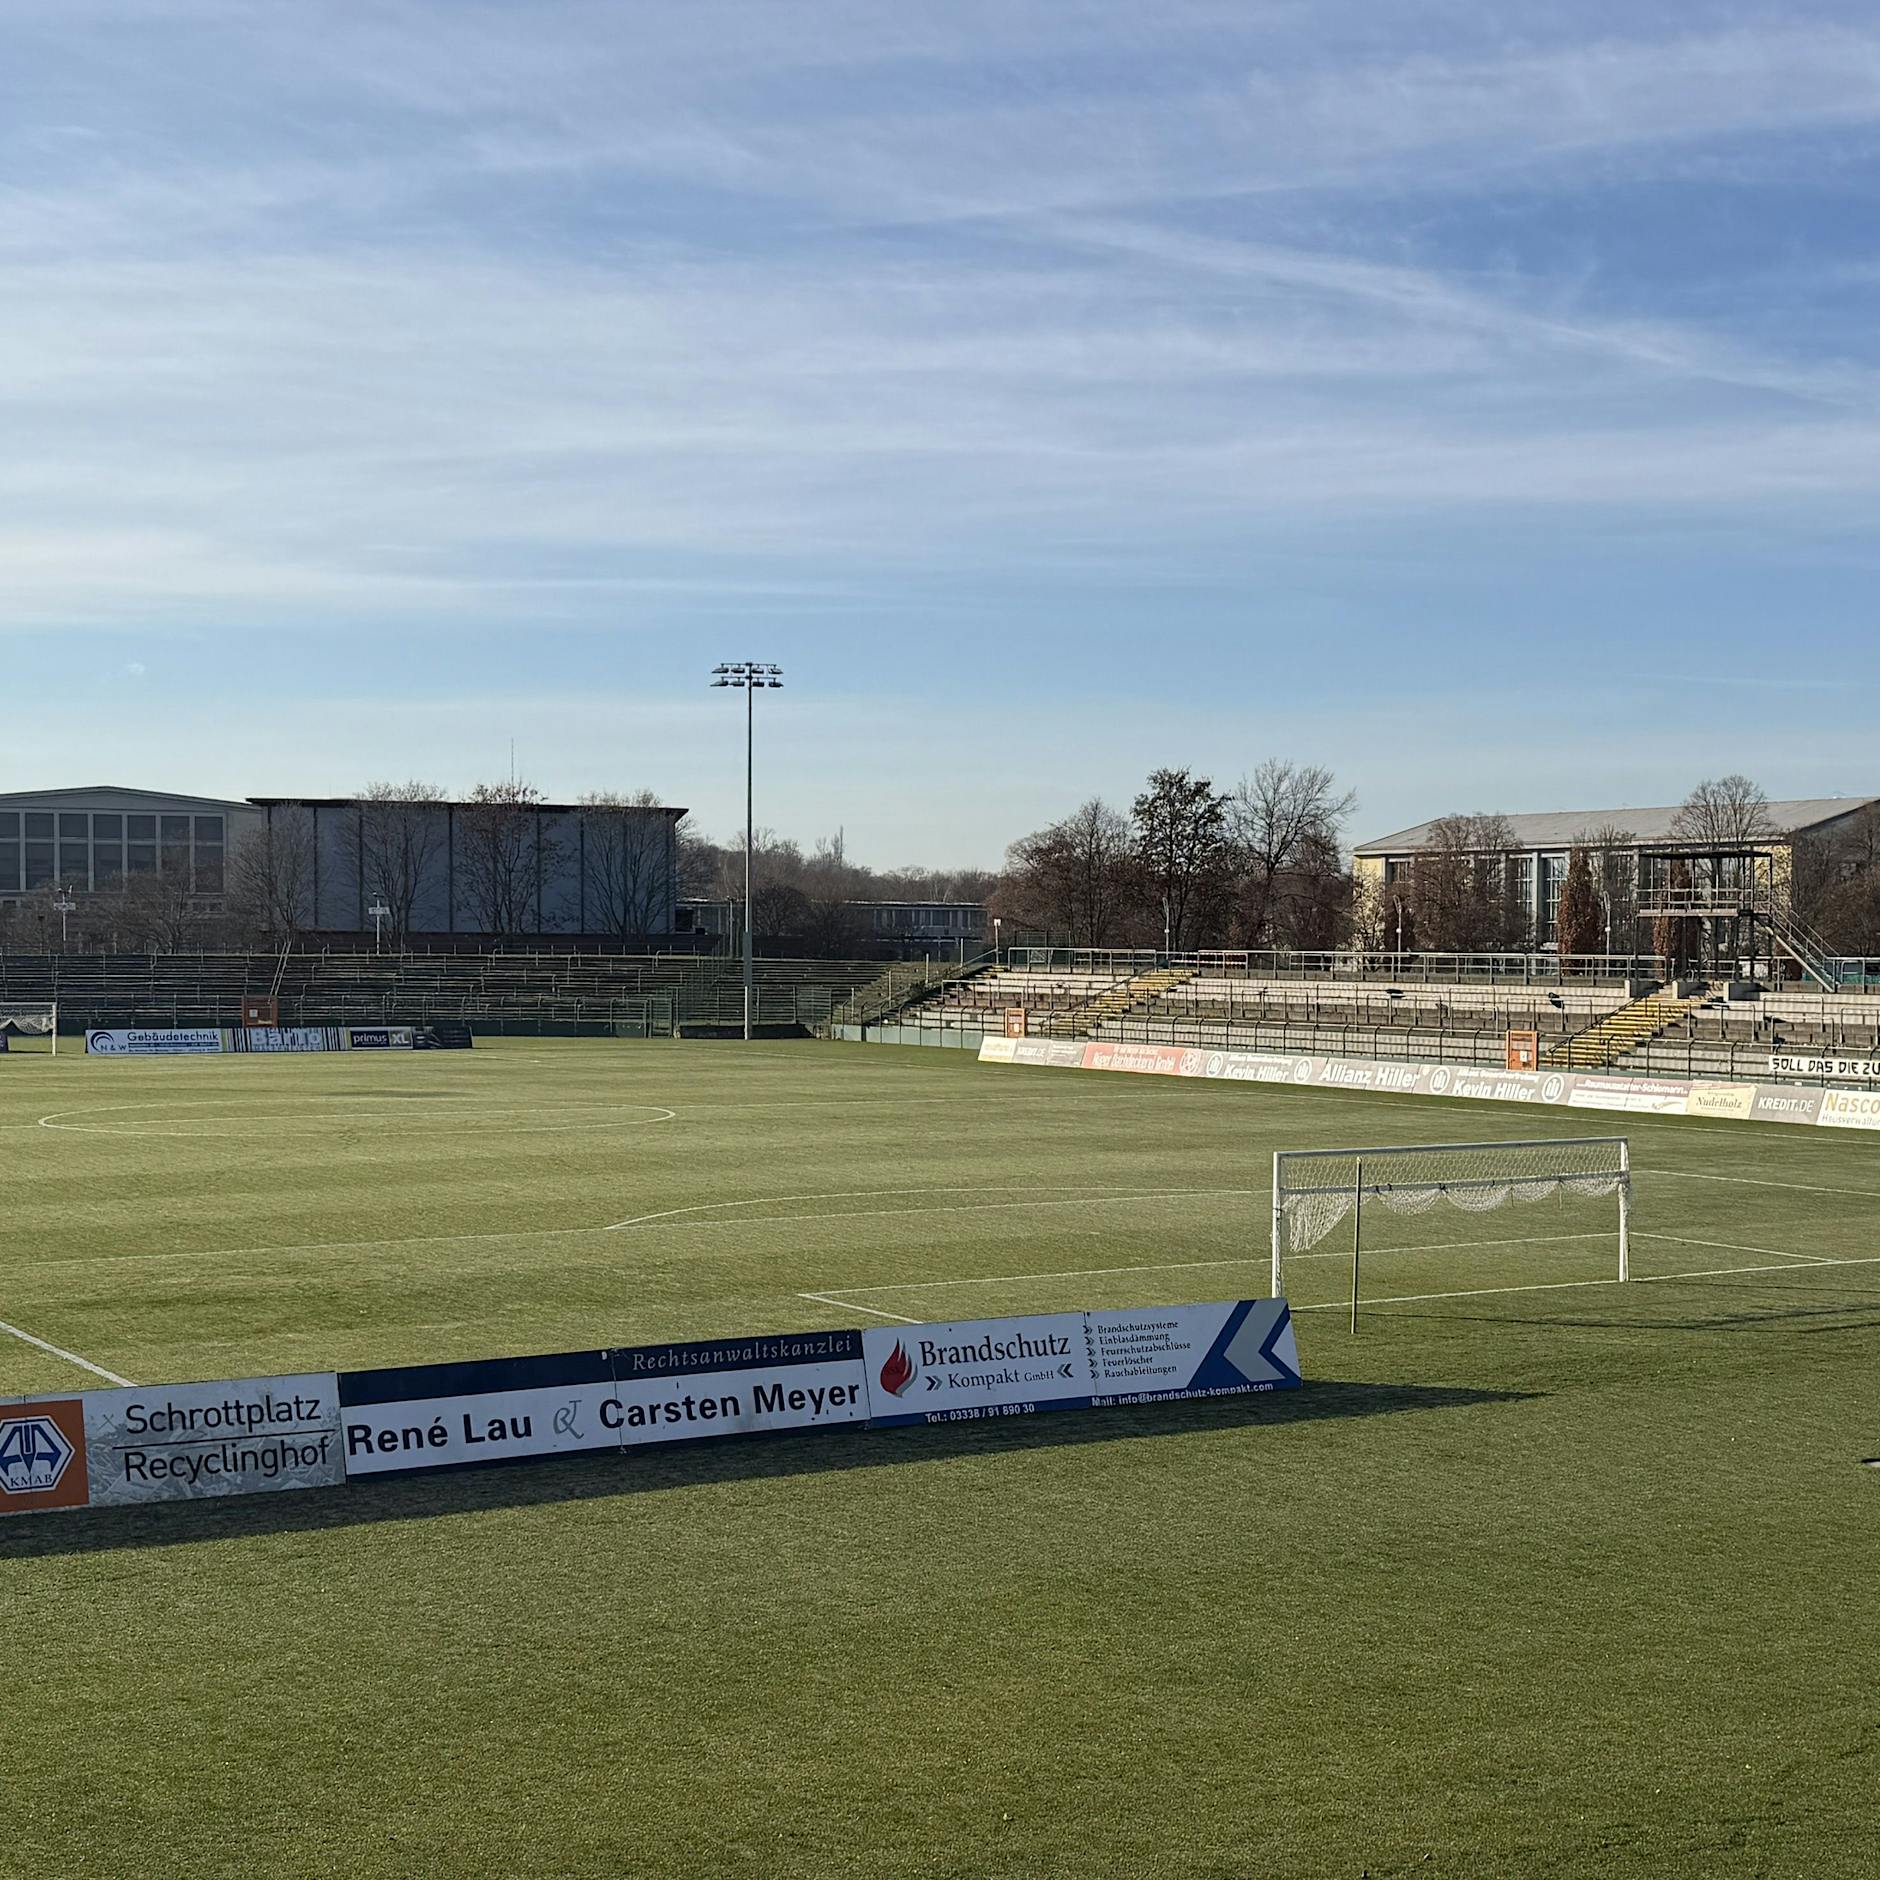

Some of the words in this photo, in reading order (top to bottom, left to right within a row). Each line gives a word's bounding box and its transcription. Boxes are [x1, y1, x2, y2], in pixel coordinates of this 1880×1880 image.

[127, 1031, 219, 1042] Gebäudetechnik
[353, 1033, 388, 1044] primus
[392, 1033, 410, 1044] XL
[1224, 1063, 1255, 1080] Kevin
[1257, 1066, 1290, 1082] Hiller
[1772, 1058, 1804, 1072] SOLL
[1808, 1060, 1833, 1073] DAS
[1839, 1061, 1859, 1075] DIE
[1320, 1064, 1373, 1085] Allianz
[1375, 1066, 1421, 1088] Hiller
[1452, 1080, 1491, 1097] Kevin
[1494, 1082, 1536, 1100] Hiller
[1696, 1096, 1743, 1109] Nudelholz
[1758, 1096, 1815, 1113] KREDIT.DE
[1097, 1321, 1179, 1334] Brandschutzsysteme
[1099, 1332, 1170, 1345] Einblasdämmung
[632, 1335, 852, 1371] Rechtsanwaltskanzlei
[918, 1333, 1072, 1367] Brandschutz
[1101, 1341, 1192, 1356] Feuerschutzabschlüsse
[1103, 1355, 1153, 1367] Feuerlöscher
[948, 1368, 1020, 1390] Kompakt
[1024, 1370, 1054, 1382] GmbH
[1105, 1365, 1177, 1378] Rauchableitungen
[1091, 1396, 1116, 1407] Mail:
[1118, 1382, 1274, 1405] info@brandschutz-kompakt.com
[126, 1394, 322, 1434] Schrottplatz
[347, 1416, 448, 1456] René
[463, 1414, 533, 1444] Lau
[599, 1395, 741, 1429] Carsten
[753, 1383, 860, 1415] Meyer
[924, 1412, 948, 1423] Tel.:
[950, 1408, 980, 1421] 03338
[988, 1406, 1000, 1418] 91
[1002, 1404, 1020, 1416] 890
[1022, 1402, 1035, 1414] 30
[124, 1435, 330, 1485] Recyclinghof
[10, 1474, 53, 1488] KMAB
